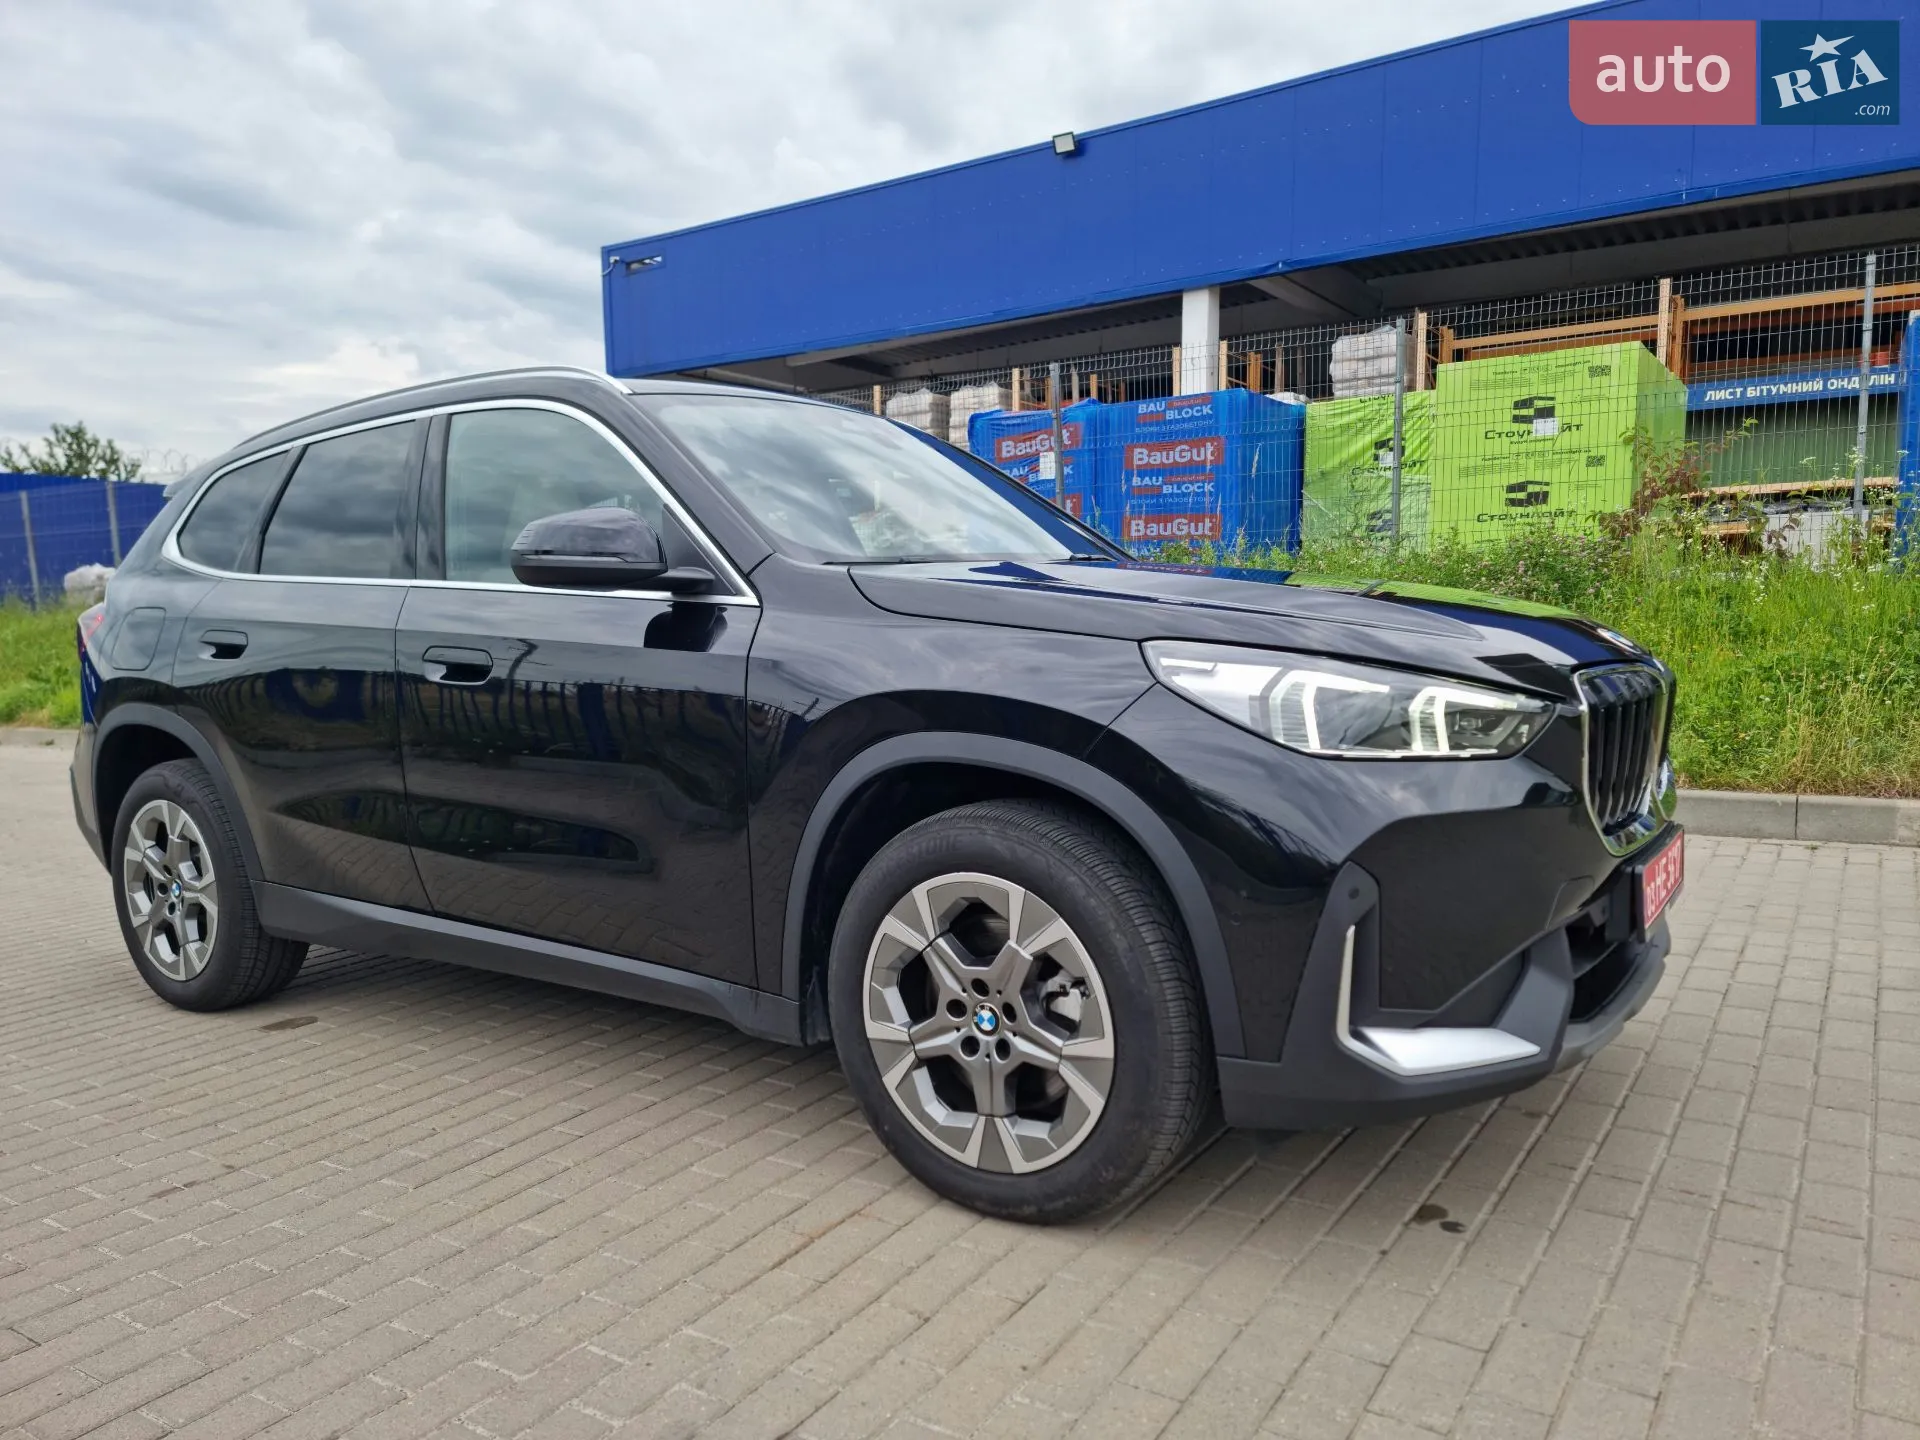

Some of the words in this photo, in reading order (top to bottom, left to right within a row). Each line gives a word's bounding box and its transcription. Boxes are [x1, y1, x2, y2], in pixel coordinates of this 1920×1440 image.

[1704, 387, 1743, 402] ЛИСТ
[1746, 378, 1823, 398] БІТУМНИЙ
[1827, 373, 1895, 390] ОНДЛІН
[1138, 401, 1165, 414] BAU
[1165, 404, 1213, 420] BLOCK
[1134, 442, 1214, 465] BauGut
[1132, 476, 1162, 486] BAU
[1163, 482, 1215, 494] BLOCK
[1130, 518, 1213, 538] BauGut
